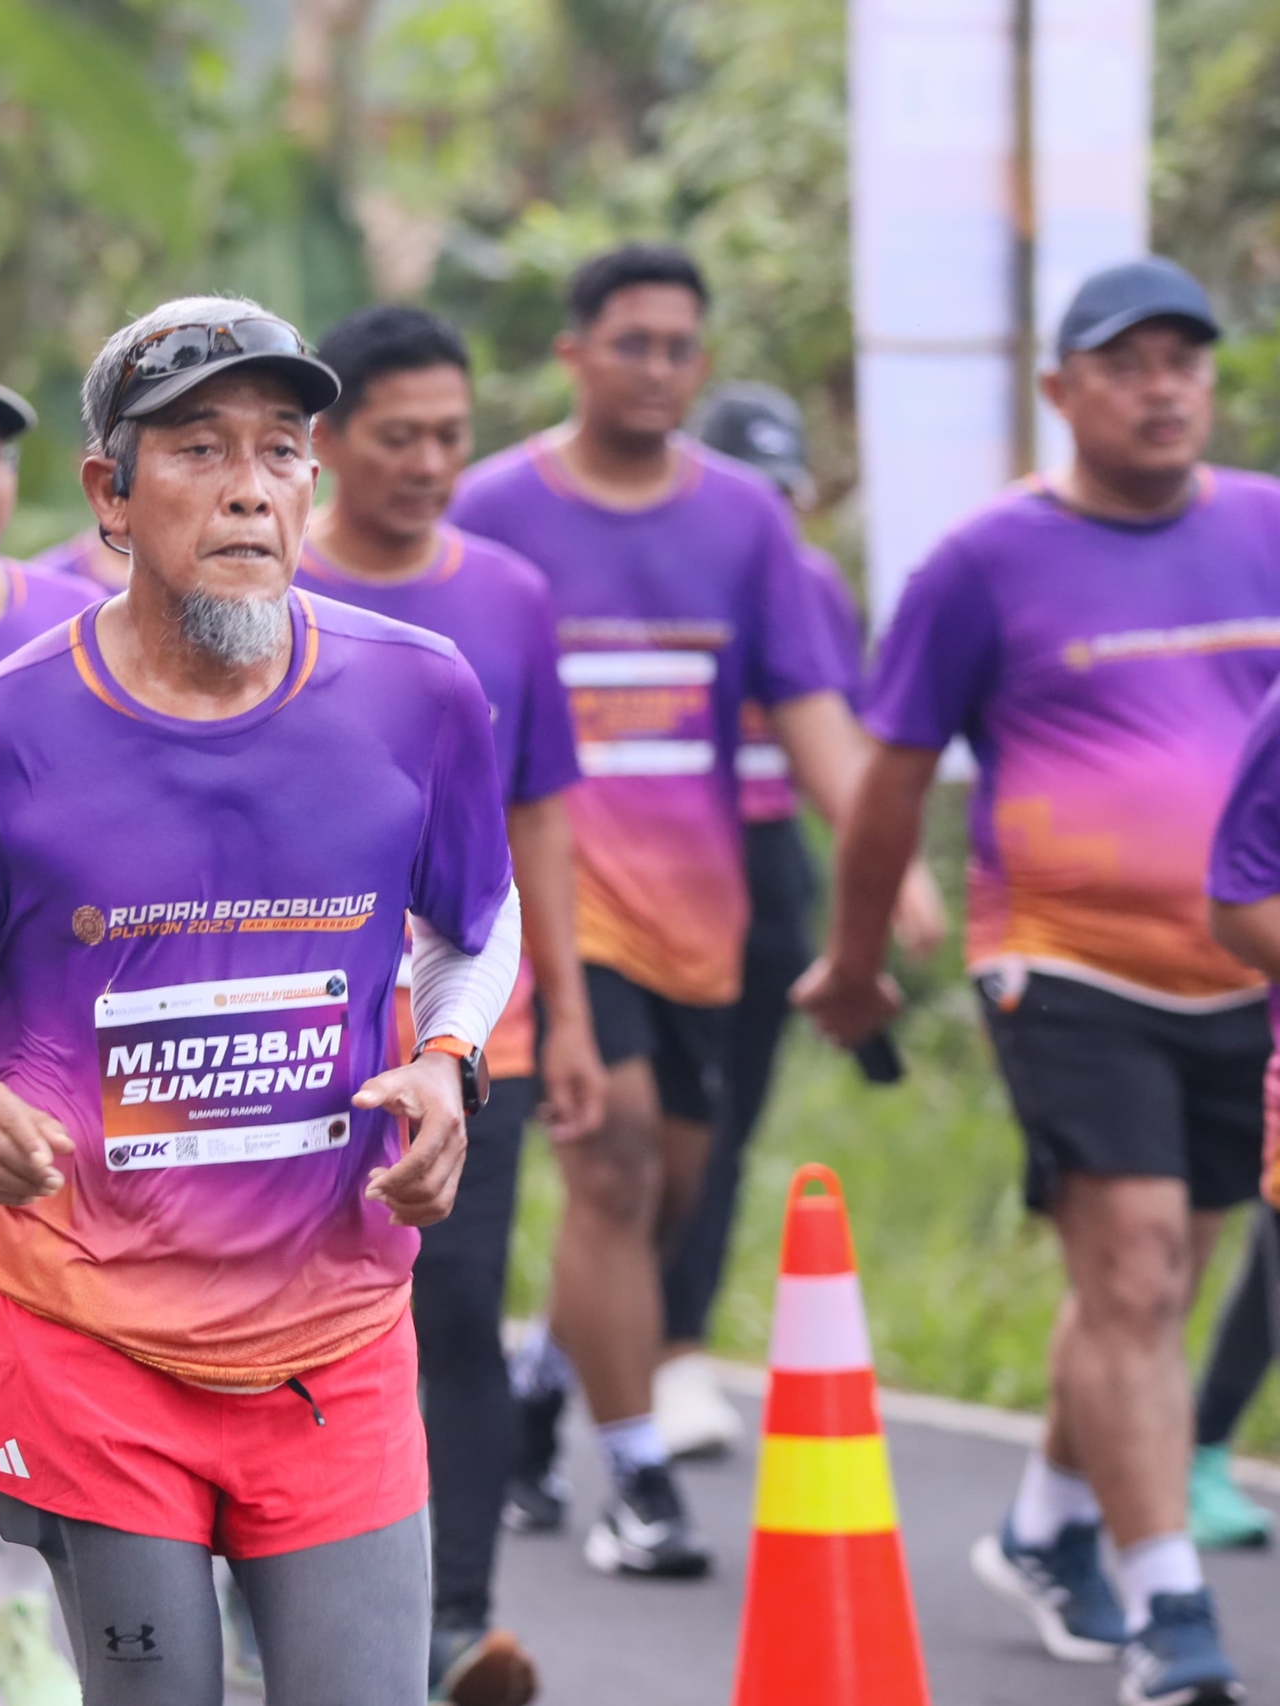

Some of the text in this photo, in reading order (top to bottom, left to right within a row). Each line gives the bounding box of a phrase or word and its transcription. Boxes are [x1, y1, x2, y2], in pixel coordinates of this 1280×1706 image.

[109, 892, 378, 929] RUPIAH BOROBUDUR
[110, 919, 182, 941] PLAYON
[186, 919, 235, 934] 2025
[272, 919, 313, 930] UNTUK
[106, 1024, 343, 1077] M.10738.M
[120, 1062, 334, 1106] SUMARNO
[188, 1104, 272, 1120] SUMARNO SUMARNO
